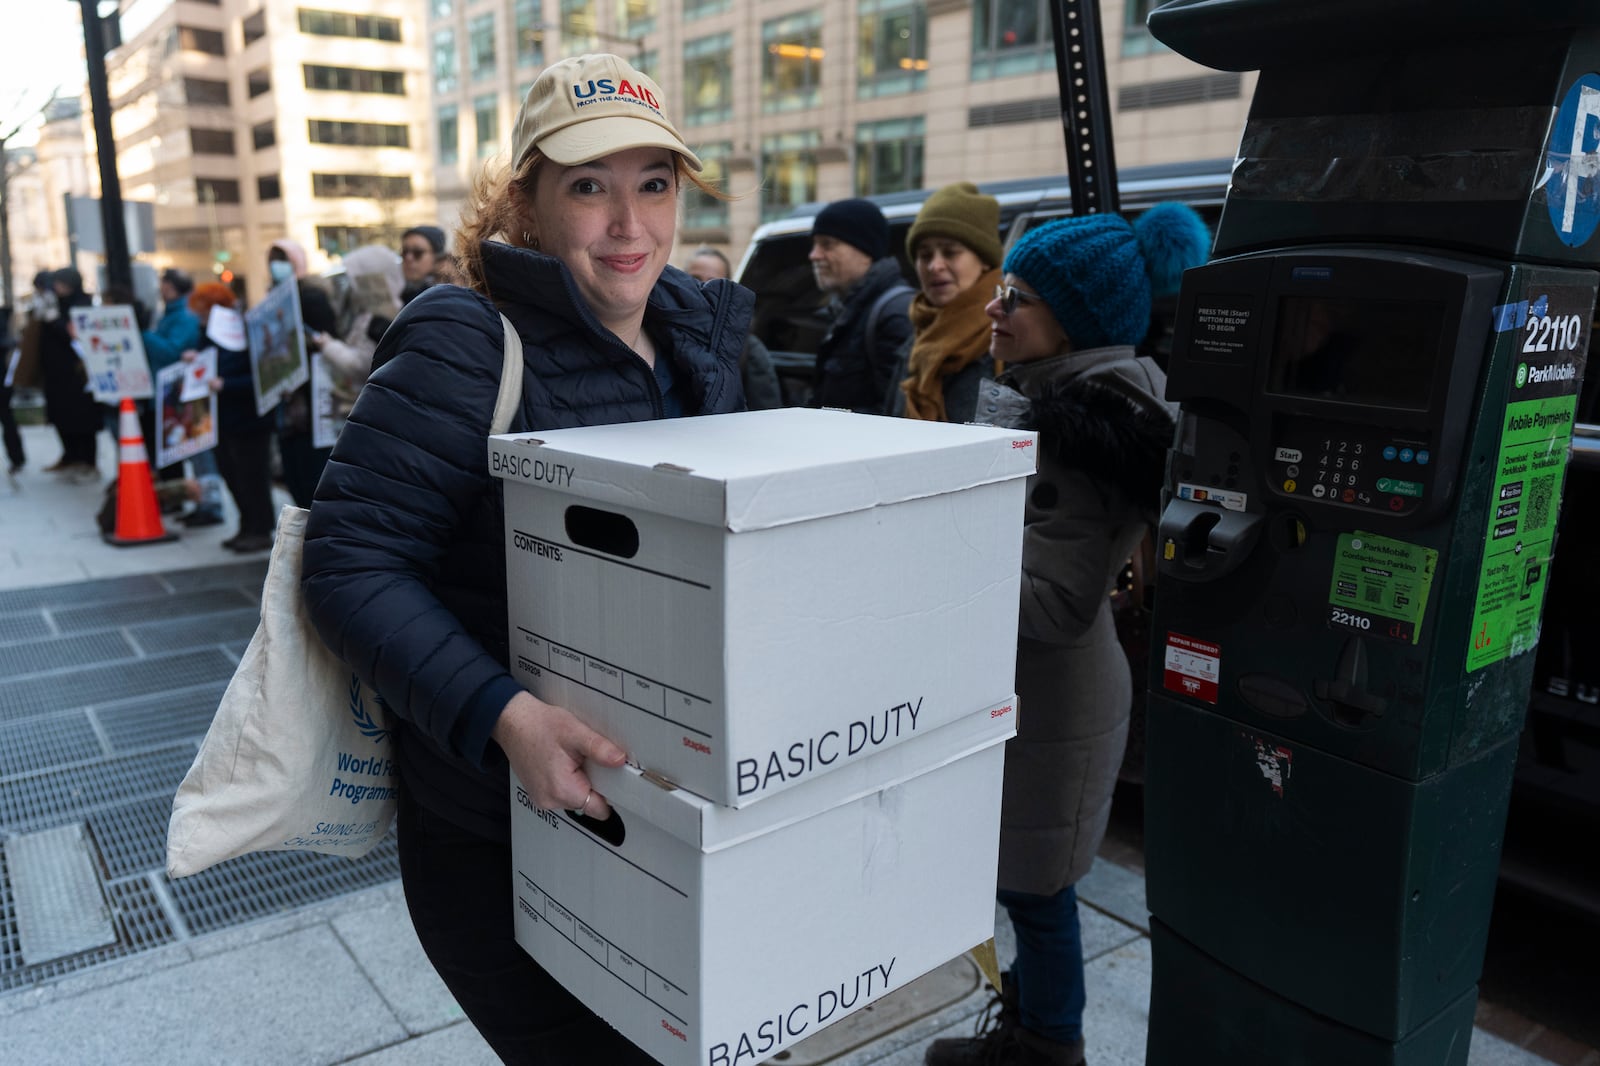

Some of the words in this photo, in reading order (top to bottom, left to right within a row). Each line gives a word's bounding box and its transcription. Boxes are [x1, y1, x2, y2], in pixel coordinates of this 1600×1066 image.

[574, 79, 660, 109] USAID
[1198, 307, 1217, 315] PRESS
[1199, 315, 1223, 323] BUTTON
[1224, 317, 1248, 325] BELOW
[1522, 314, 1581, 353] 22110
[1528, 363, 1576, 383] ParkMobile
[1508, 412, 1533, 432] Mobile
[1534, 409, 1572, 429] Payments
[1012, 439, 1033, 450] Staples
[1324, 440, 1331, 450] 1
[1339, 442, 1347, 452] 2
[1355, 444, 1362, 454] 3
[1280, 450, 1299, 461] Start
[1320, 456, 1328, 466] 4
[1336, 457, 1344, 468] 5
[1351, 460, 1359, 470] 6
[492, 451, 531, 477] BASIC
[534, 461, 575, 487] DUTY
[1319, 470, 1326, 481] 7
[1333, 473, 1340, 483] 8
[1348, 475, 1356, 486] 9
[1330, 488, 1337, 499] 0
[513, 534, 563, 562] CONTENTS:
[1363, 543, 1410, 558] ParkMobile
[1342, 550, 1386, 565] Contactless
[1387, 559, 1417, 573] Parking
[1331, 610, 1371, 630] 22110
[1169, 636, 1191, 647] REPAIR
[1191, 642, 1218, 654] NEEDED?
[636, 679, 650, 691] FROM
[683, 697, 692, 706] TO
[991, 705, 1012, 718] Staples
[683, 736, 711, 755] Staples
[737, 731, 840, 796] BASIC
[848, 696, 923, 757] DUTY
[338, 752, 383, 776] World
[311, 822, 356, 836] SAVING
[620, 955, 633, 967] FROM
[708, 1003, 809, 1066] BASIC
[817, 957, 896, 1024] DUTY
[661, 1019, 687, 1042] Staples
